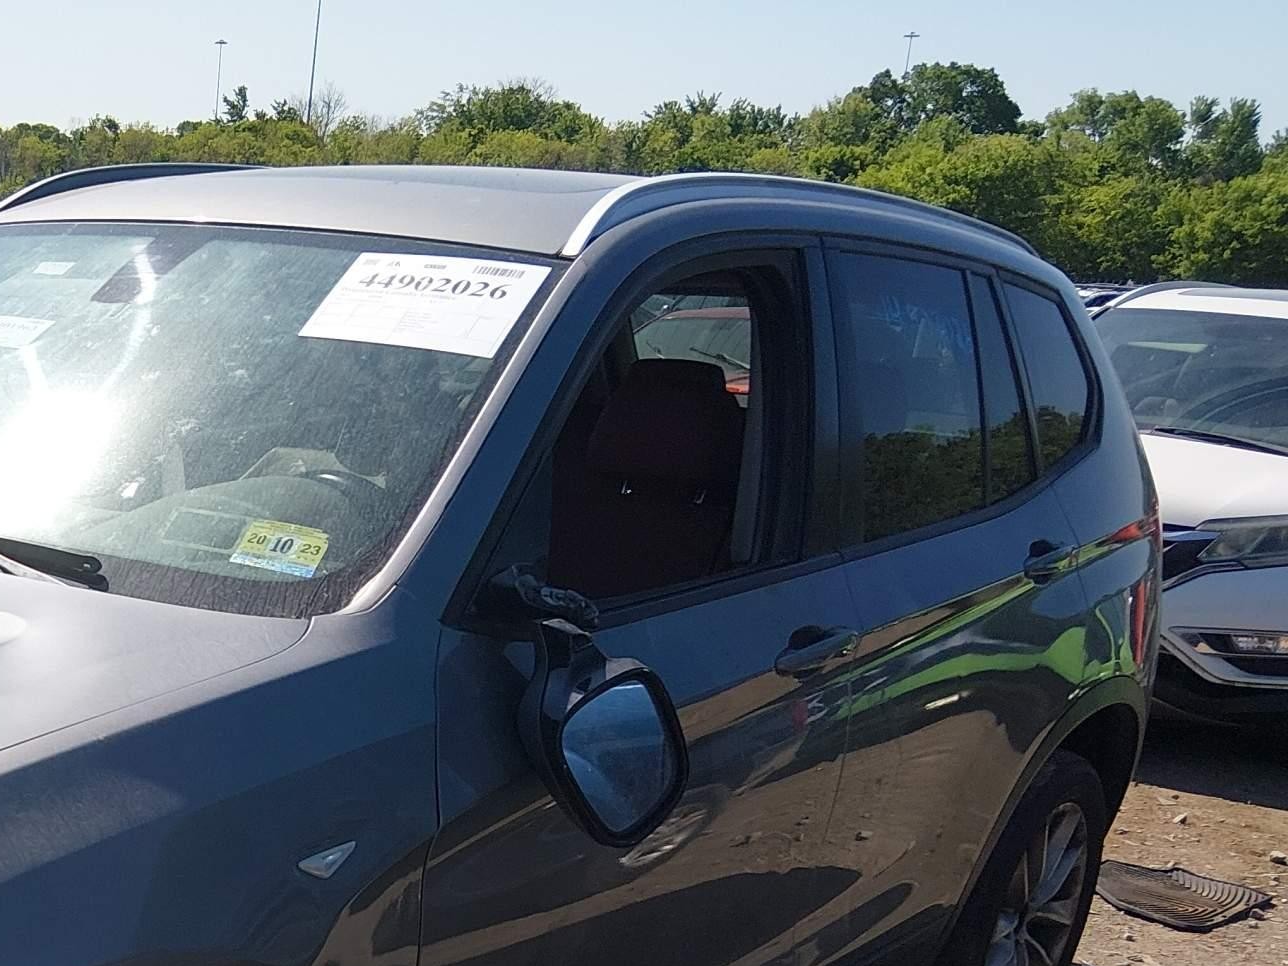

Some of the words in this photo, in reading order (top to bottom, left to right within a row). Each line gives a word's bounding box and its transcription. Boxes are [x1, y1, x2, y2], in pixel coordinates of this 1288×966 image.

[359, 272, 513, 300] 44902026
[247, 533, 267, 545] 20
[269, 537, 294, 554] 10
[300, 543, 322, 556] 23
